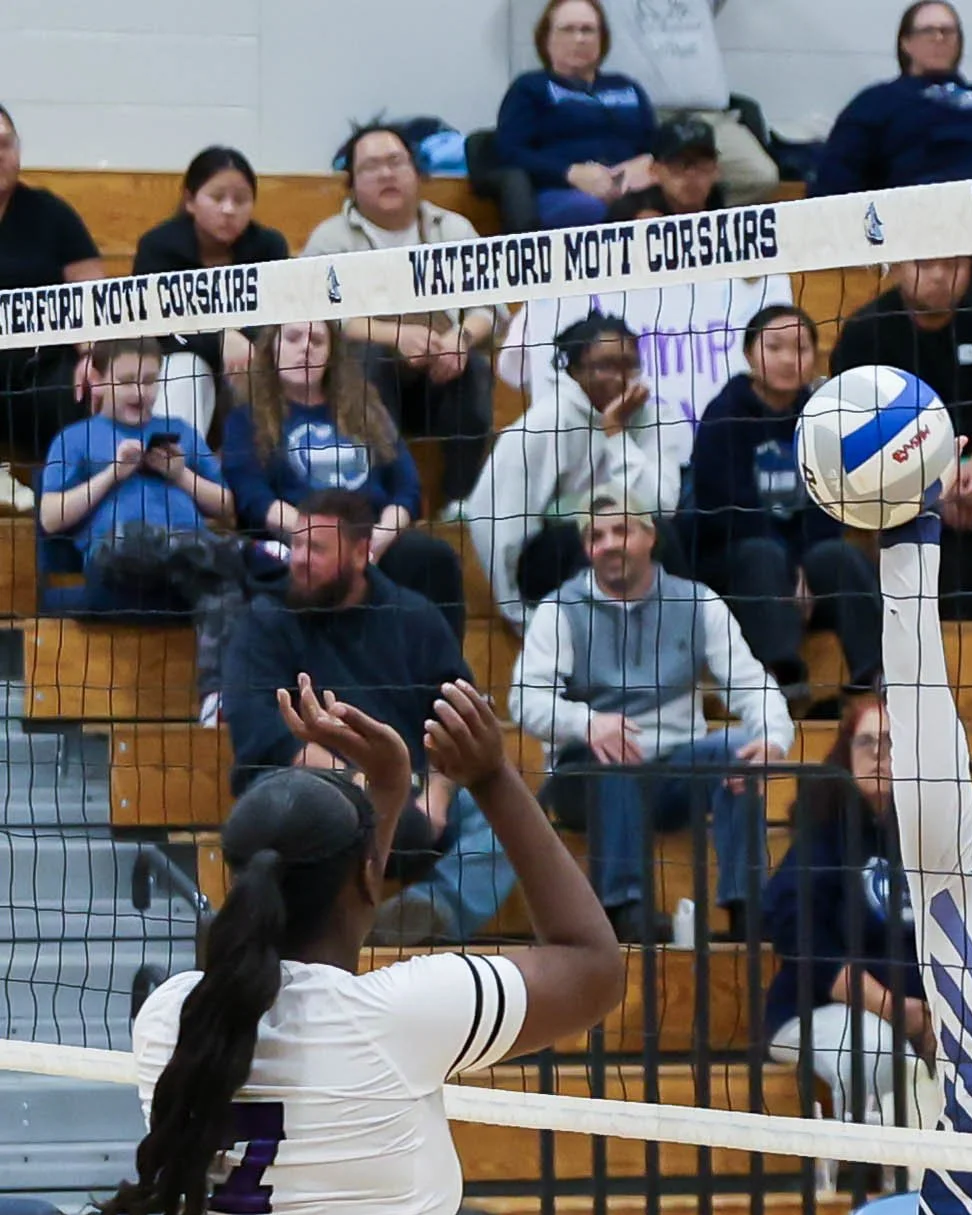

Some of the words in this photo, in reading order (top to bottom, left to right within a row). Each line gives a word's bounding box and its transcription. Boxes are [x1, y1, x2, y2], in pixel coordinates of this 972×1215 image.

[408, 235, 552, 297] WATERFORD
[564, 226, 634, 281] MOTT
[646, 207, 778, 272] CORSAIRS
[0, 286, 84, 336] TERFORD
[92, 278, 149, 326] MOTT
[157, 267, 258, 318] CORSAIRS
